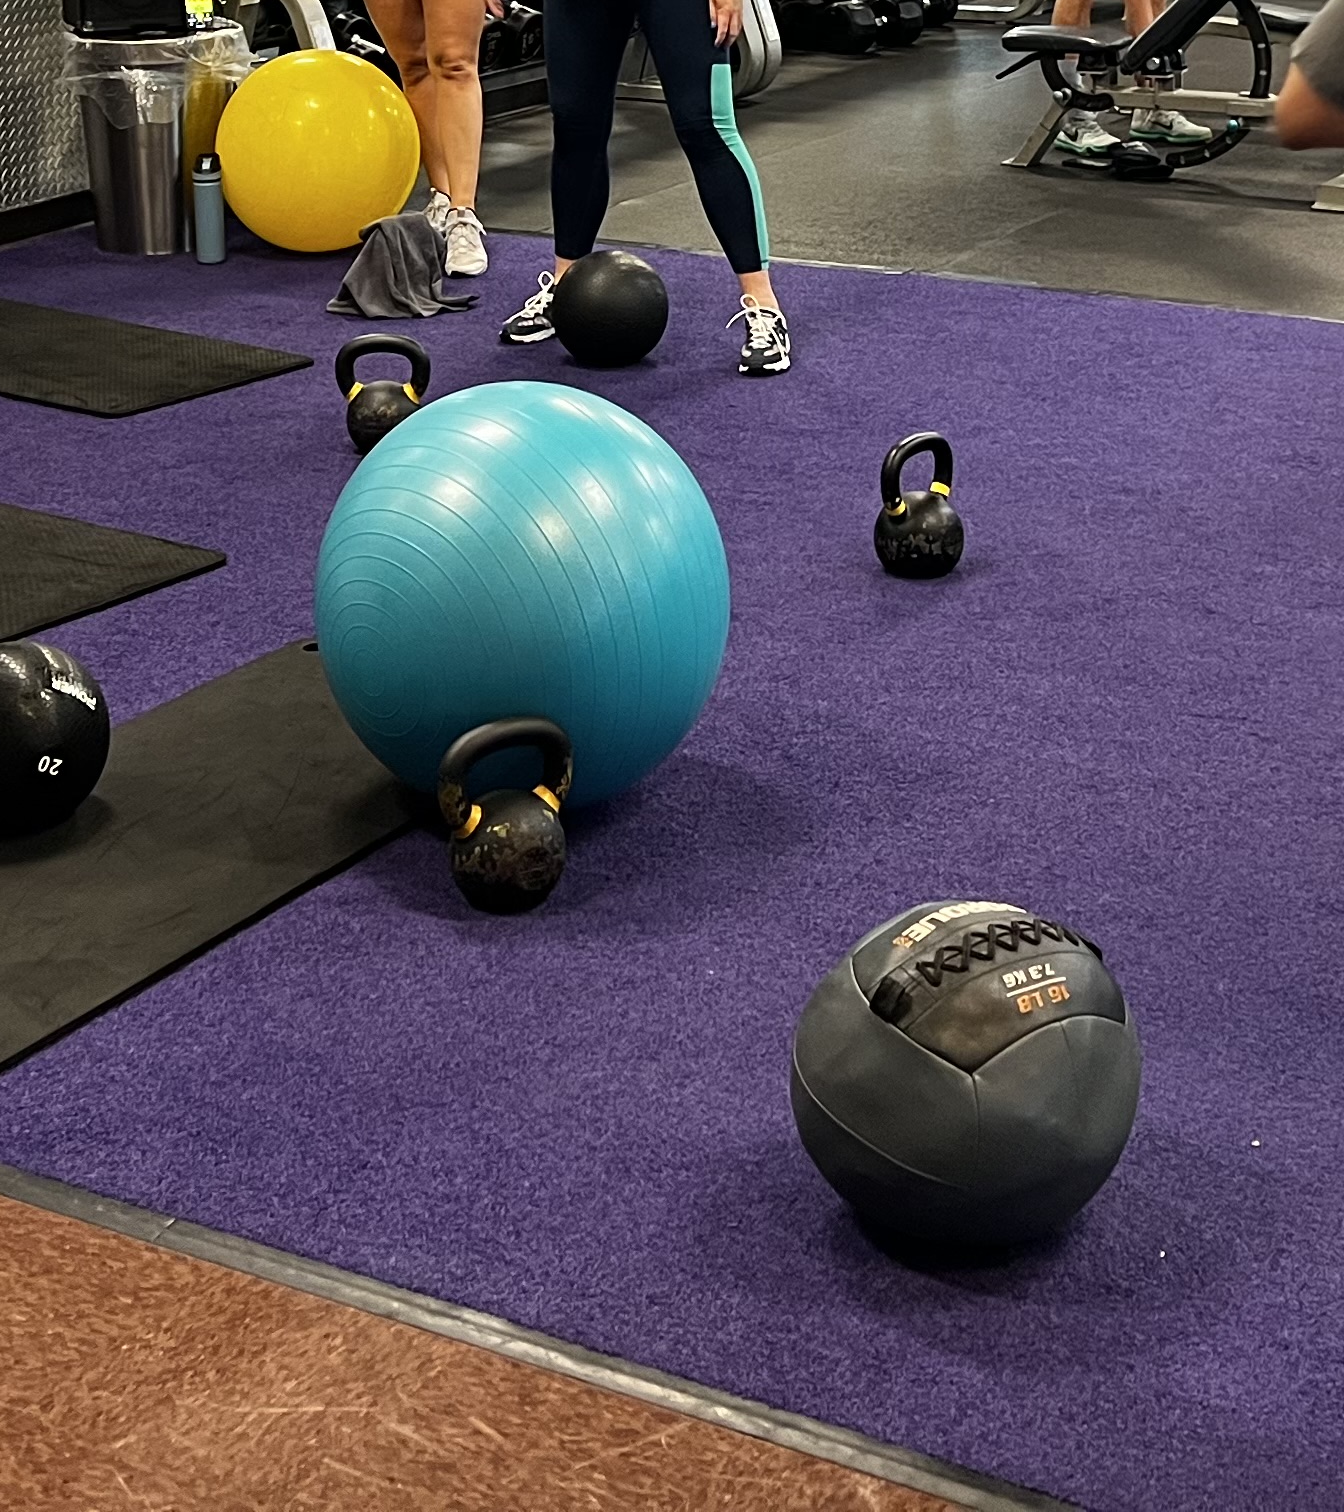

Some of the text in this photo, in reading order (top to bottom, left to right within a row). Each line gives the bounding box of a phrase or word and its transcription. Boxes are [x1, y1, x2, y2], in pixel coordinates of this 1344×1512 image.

[38, 755, 63, 776] 20
[1002, 962, 1056, 989] 7.3 KG
[1016, 984, 1071, 1014] 16 LB
